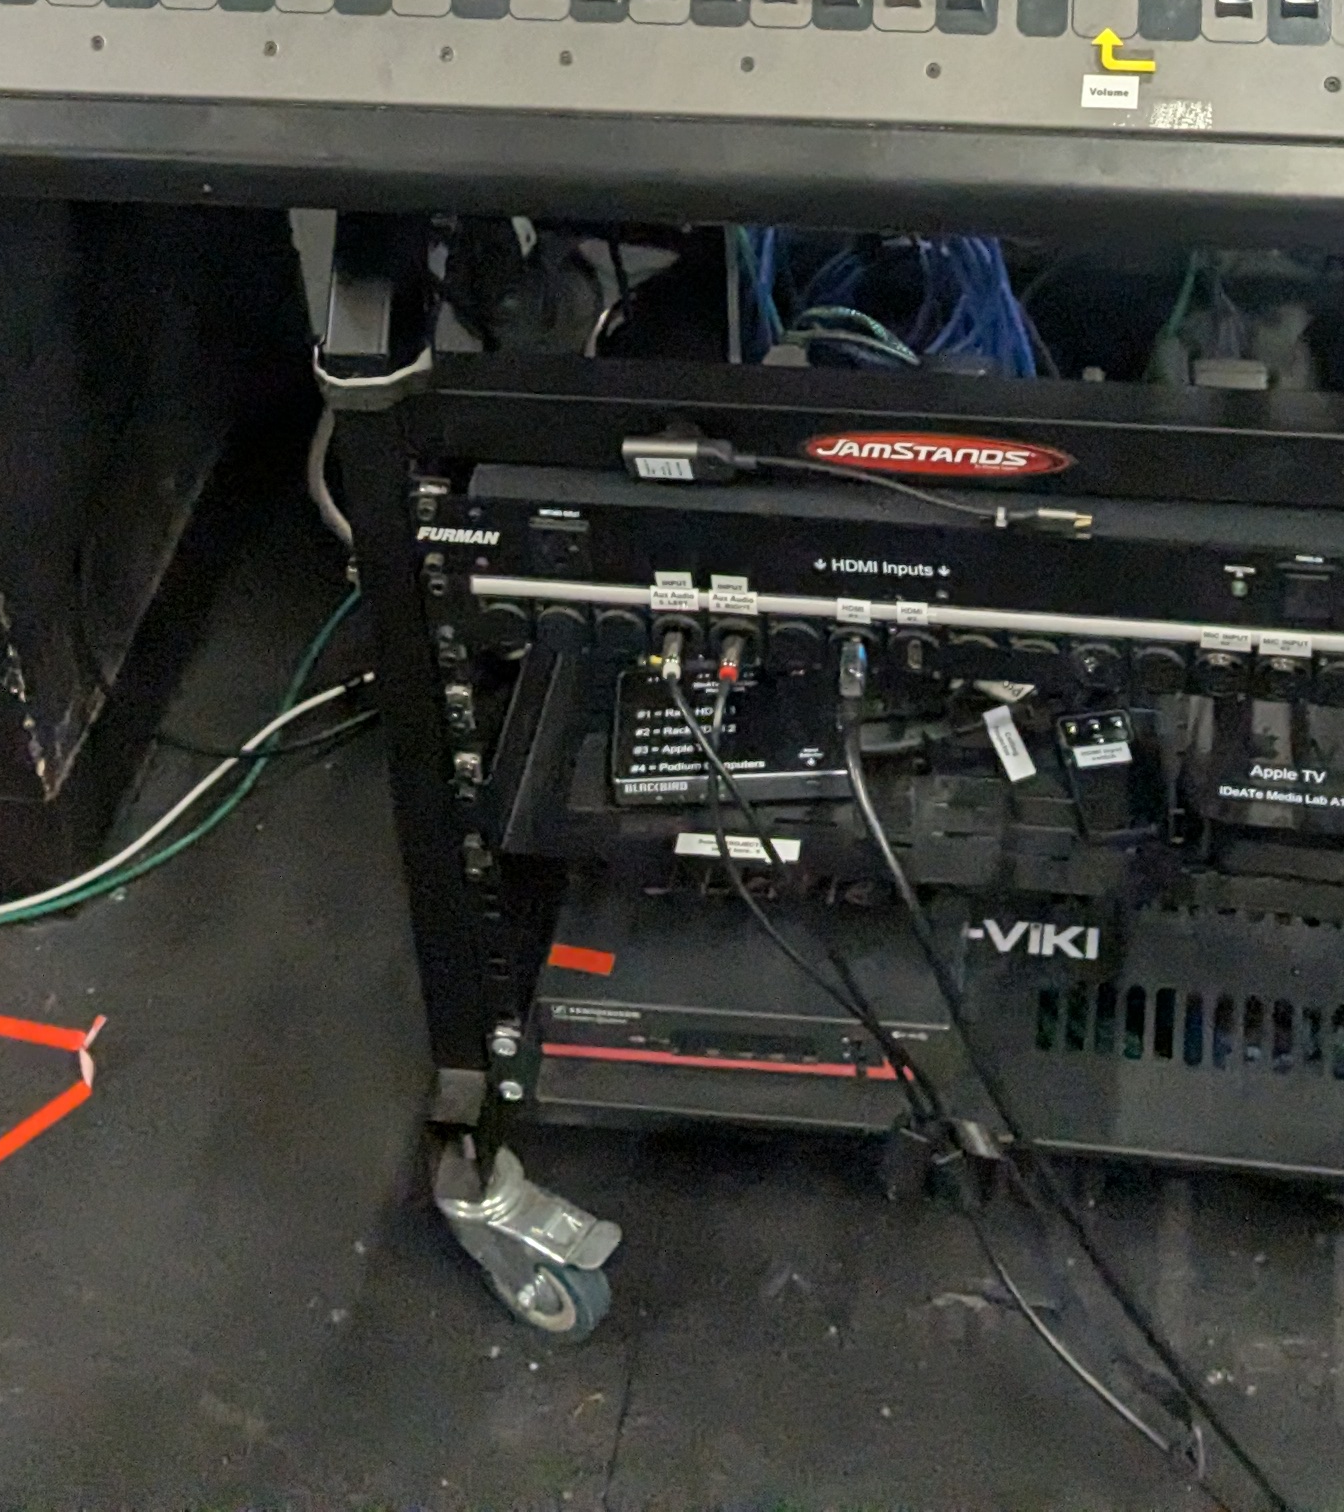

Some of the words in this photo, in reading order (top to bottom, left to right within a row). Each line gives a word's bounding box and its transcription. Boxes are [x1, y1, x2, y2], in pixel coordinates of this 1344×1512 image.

[1090, 88, 1129, 97] Volume
[417, 526, 500, 545] FURMAN
[831, 558, 878, 573] HDMI
[882, 561, 933, 577] Inputs
[653, 591, 668, 599] Aux
[670, 591, 695, 600] Audio
[712, 594, 728, 602] Aux
[730, 595, 754, 603] Audio
[637, 710, 651, 719] #1
[635, 727, 650, 737] #2
[633, 745, 648, 755] #3
[661, 743, 694, 755] Apple
[630, 763, 647, 773] #4
[659, 761, 702, 772] Podium
[1250, 764, 1298, 781] Apple
[1301, 769, 1327, 784] TV
[1218, 785, 1264, 800] IDeATe
[1266, 790, 1303, 804] Media
[1305, 794, 1328, 806] Lab
